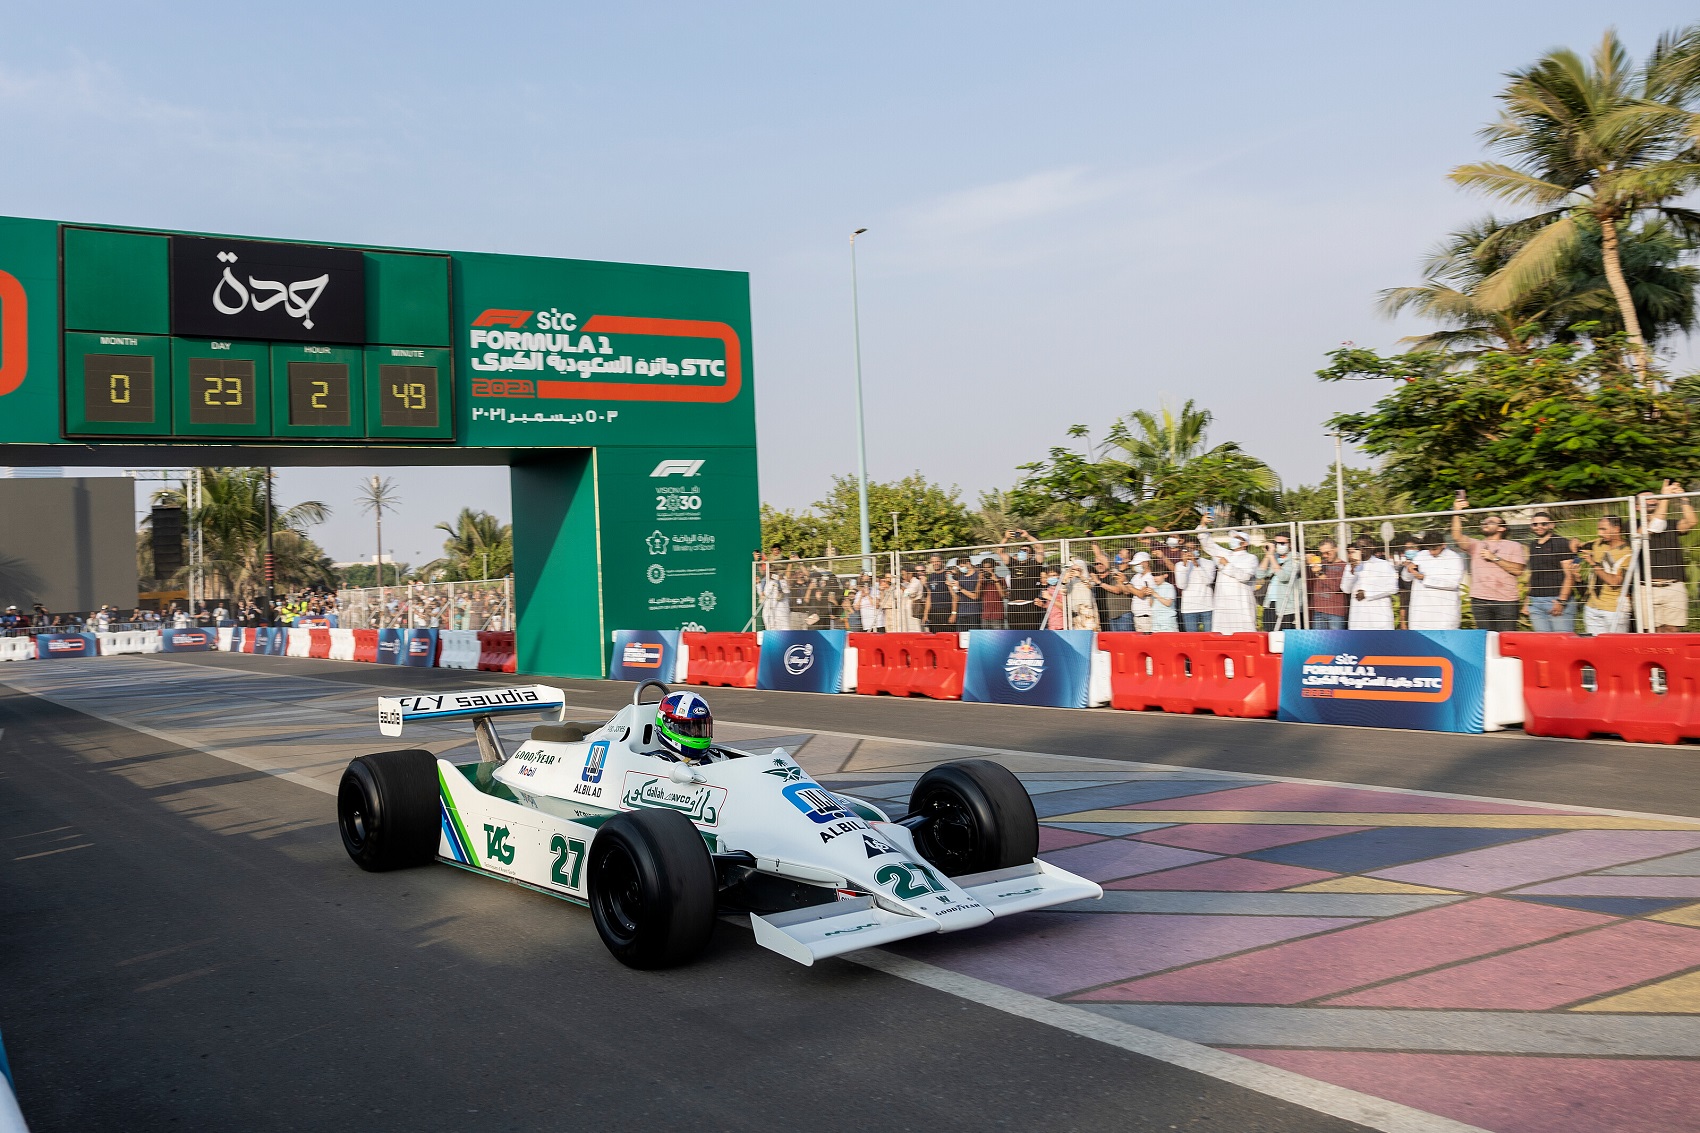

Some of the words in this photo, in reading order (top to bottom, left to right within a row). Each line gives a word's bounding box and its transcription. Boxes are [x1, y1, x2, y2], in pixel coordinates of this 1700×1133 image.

[212, 251, 330, 330] جدة
[100, 336, 138, 346] MONTH
[210, 341, 231, 350] DAY
[469, 329, 597, 354] FORMULA
[597, 335, 614, 355] 1
[304, 346, 331, 354] HOUR
[391, 349, 424, 358] MINUTE
[681, 358, 726, 378] STC
[109, 374, 131, 404] 0
[203, 377, 243, 406] 23
[311, 381, 329, 409] 2
[391, 383, 427, 409] 49
[471, 378, 536, 399] 2021
[472, 407, 507, 421] ٢٠٢١
[506, 412, 585, 425] ديسمبر
[1302, 665, 1367, 676] FORMULA
[1412, 677, 1443, 688] STC
[518, 764, 538, 778] Mobil
[573, 783, 603, 798] ALBILAD
[646, 786, 665, 800] dallah
[483, 823, 516, 866] TAG
[550, 833, 587, 891] 27
[874, 862, 950, 901] 27
